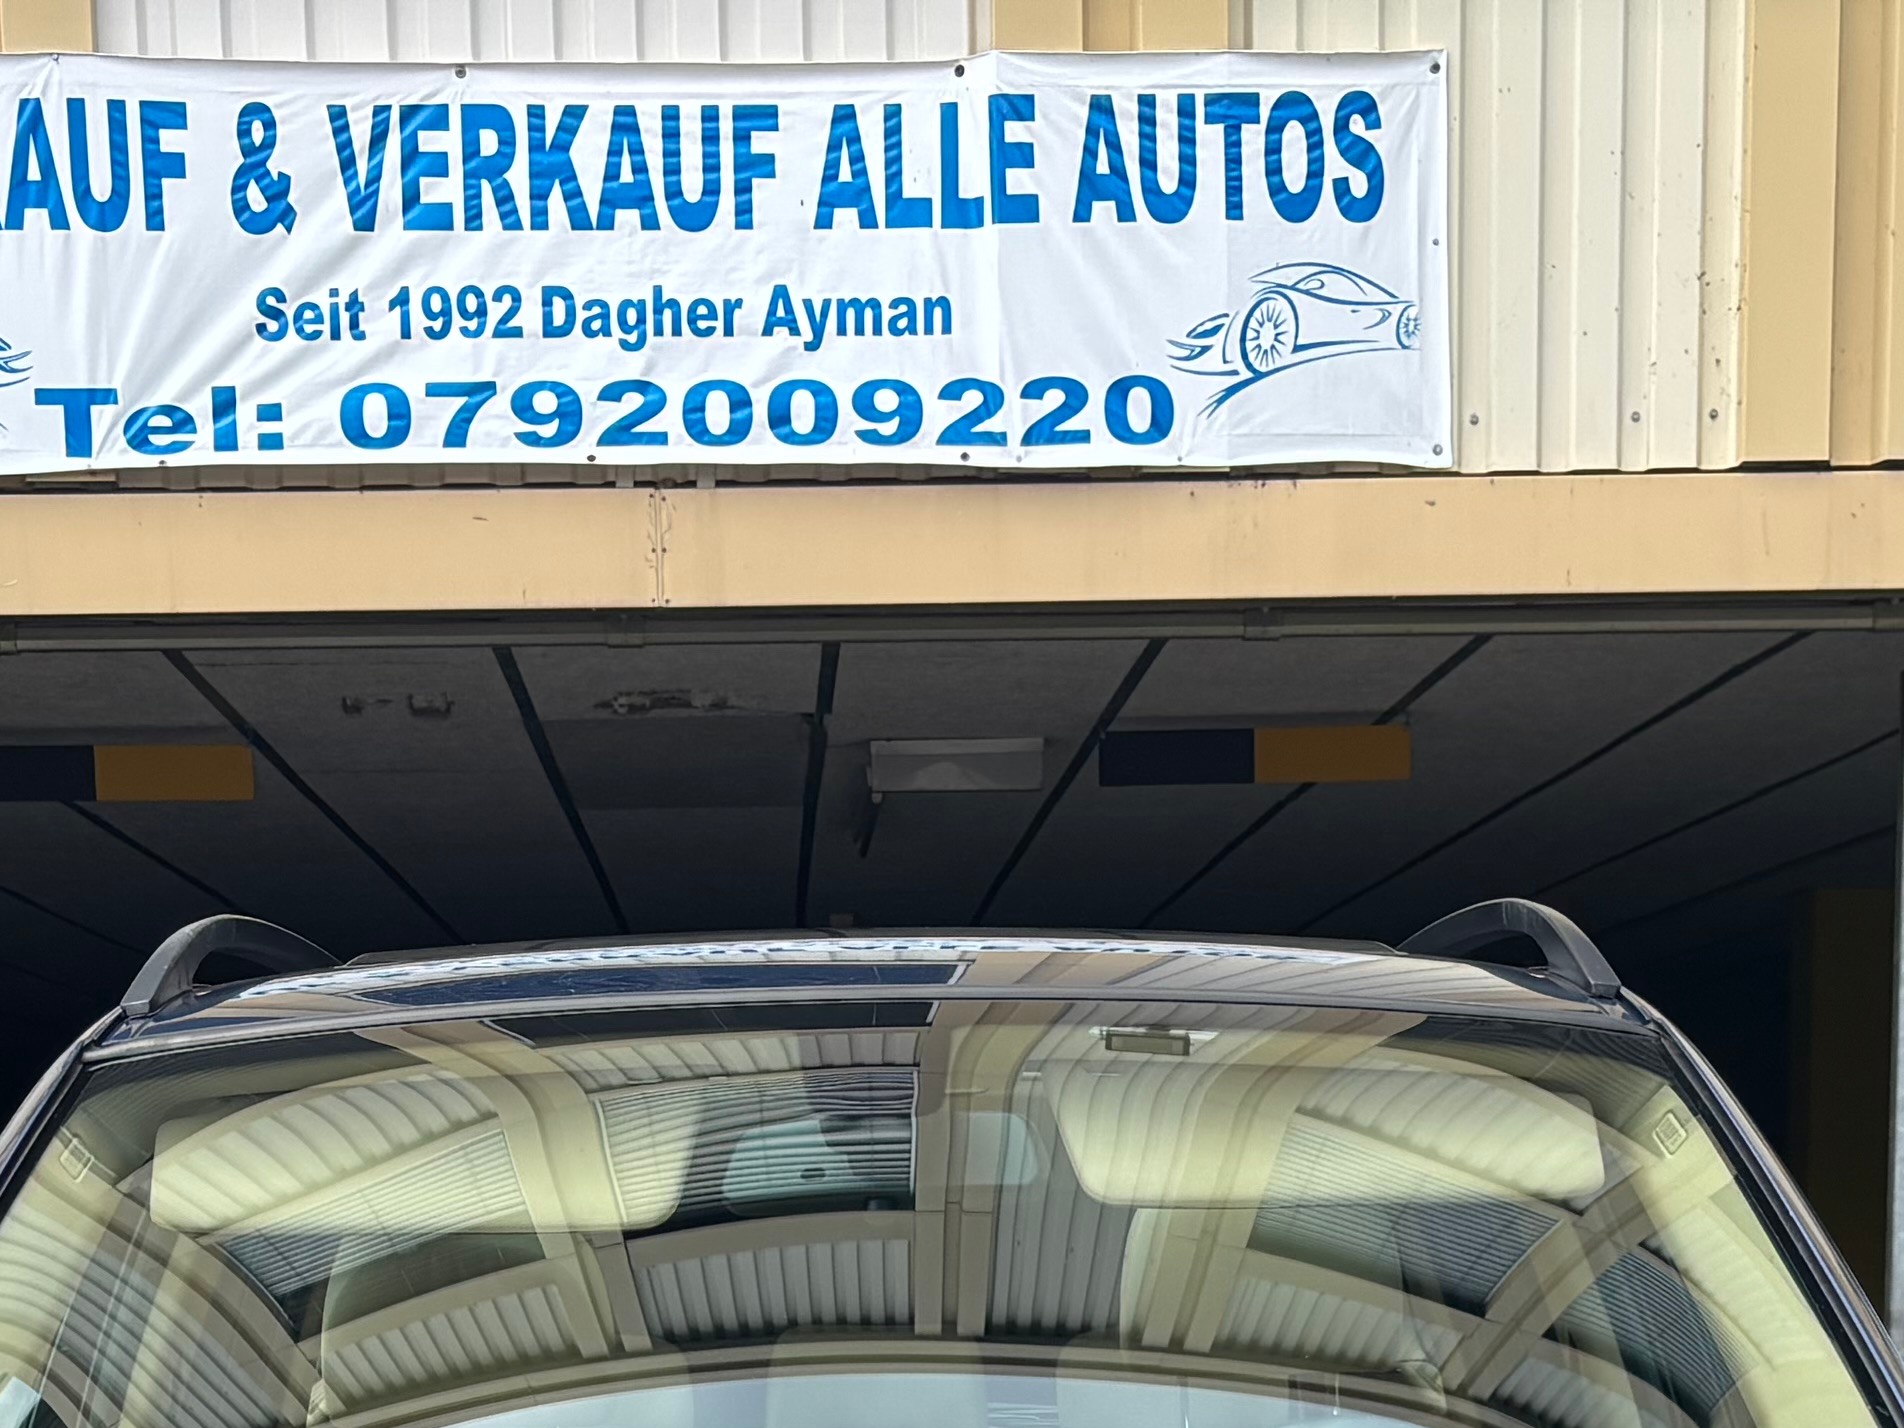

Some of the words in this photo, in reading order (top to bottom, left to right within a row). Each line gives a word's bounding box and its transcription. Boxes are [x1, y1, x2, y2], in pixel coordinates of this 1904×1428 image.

[231, 102, 297, 235] &
[328, 103, 779, 233] VERKAUF
[814, 93, 1040, 230] ALLE
[1073, 90, 1385, 224] AUTOS
[256, 288, 366, 342] Seit
[389, 285, 524, 341] 1992
[541, 285, 743, 352] Dagher
[762, 284, 952, 352] Ayman
[34, 386, 284, 459] Tel:
[340, 375, 1175, 450] 0792009220
